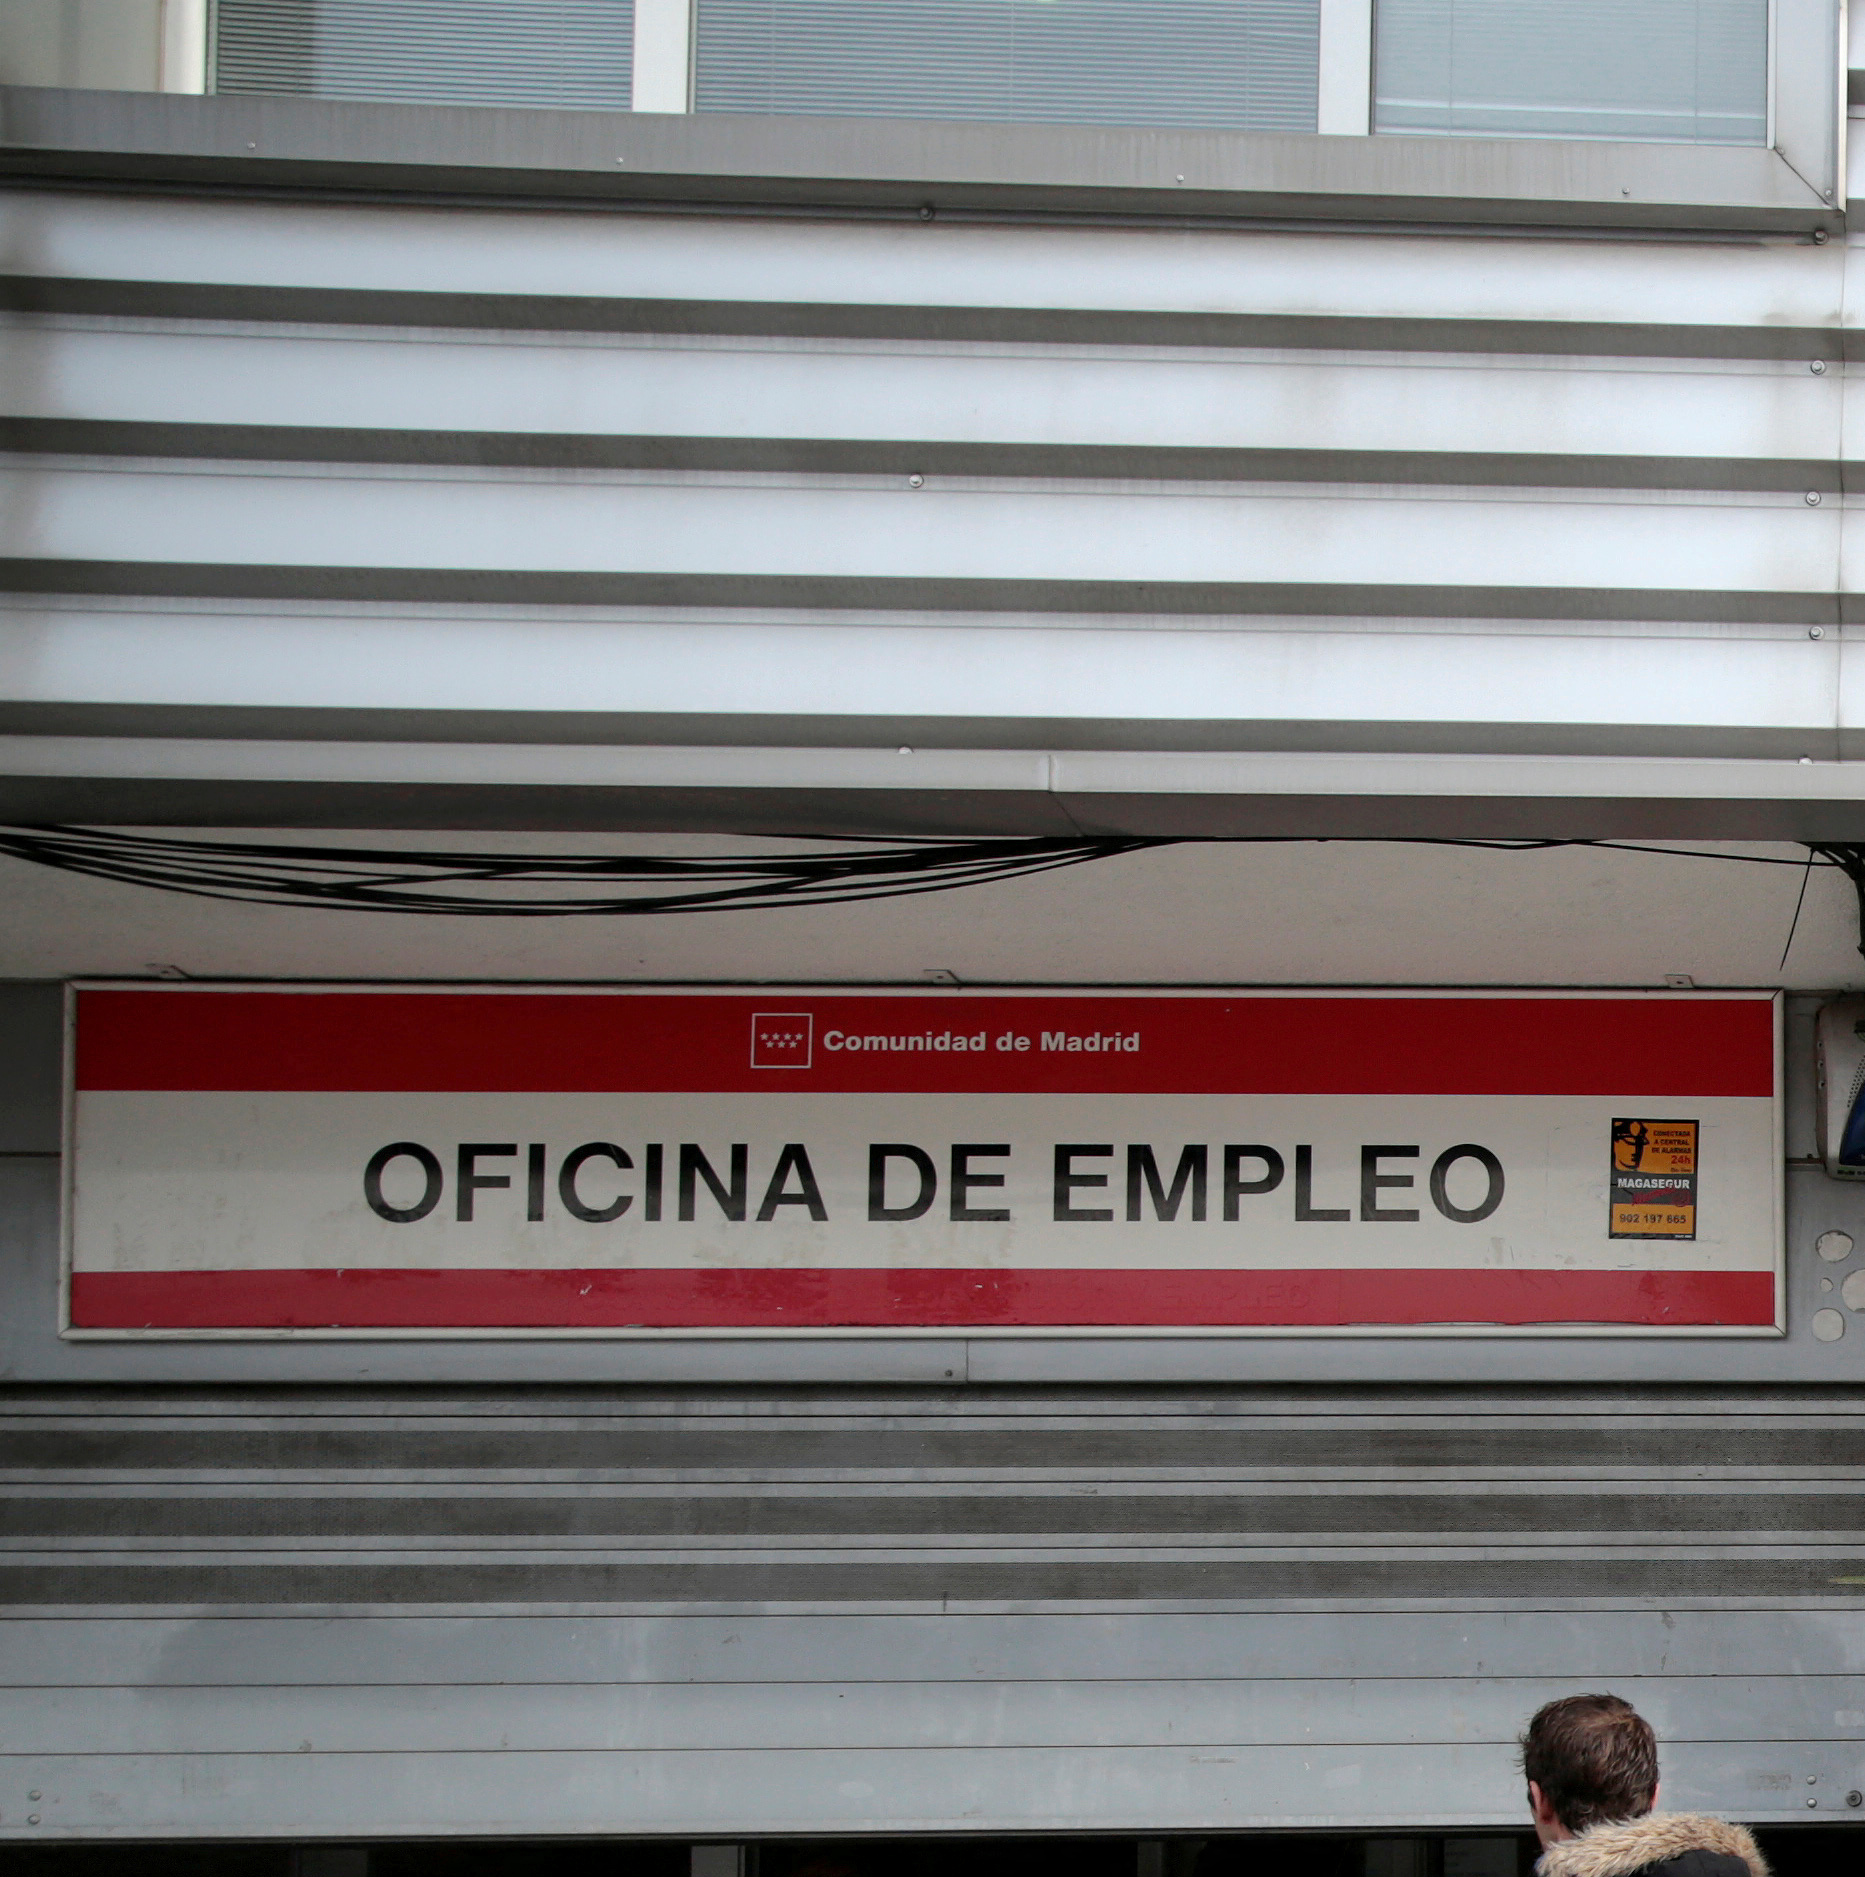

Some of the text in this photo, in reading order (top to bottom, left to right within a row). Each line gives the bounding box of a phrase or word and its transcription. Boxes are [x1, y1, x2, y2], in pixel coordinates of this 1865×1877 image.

[823, 1029, 1142, 1055] Comunidad de Madrid
[1671, 1155, 1691, 1164] 24h
[363, 1141, 1507, 1225] OFICINA DE EMPLEO
[1617, 1178, 1690, 1190] MAGASEGUR
[1619, 1213, 1640, 1224] 902
[1644, 1213, 1663, 1224] 197
